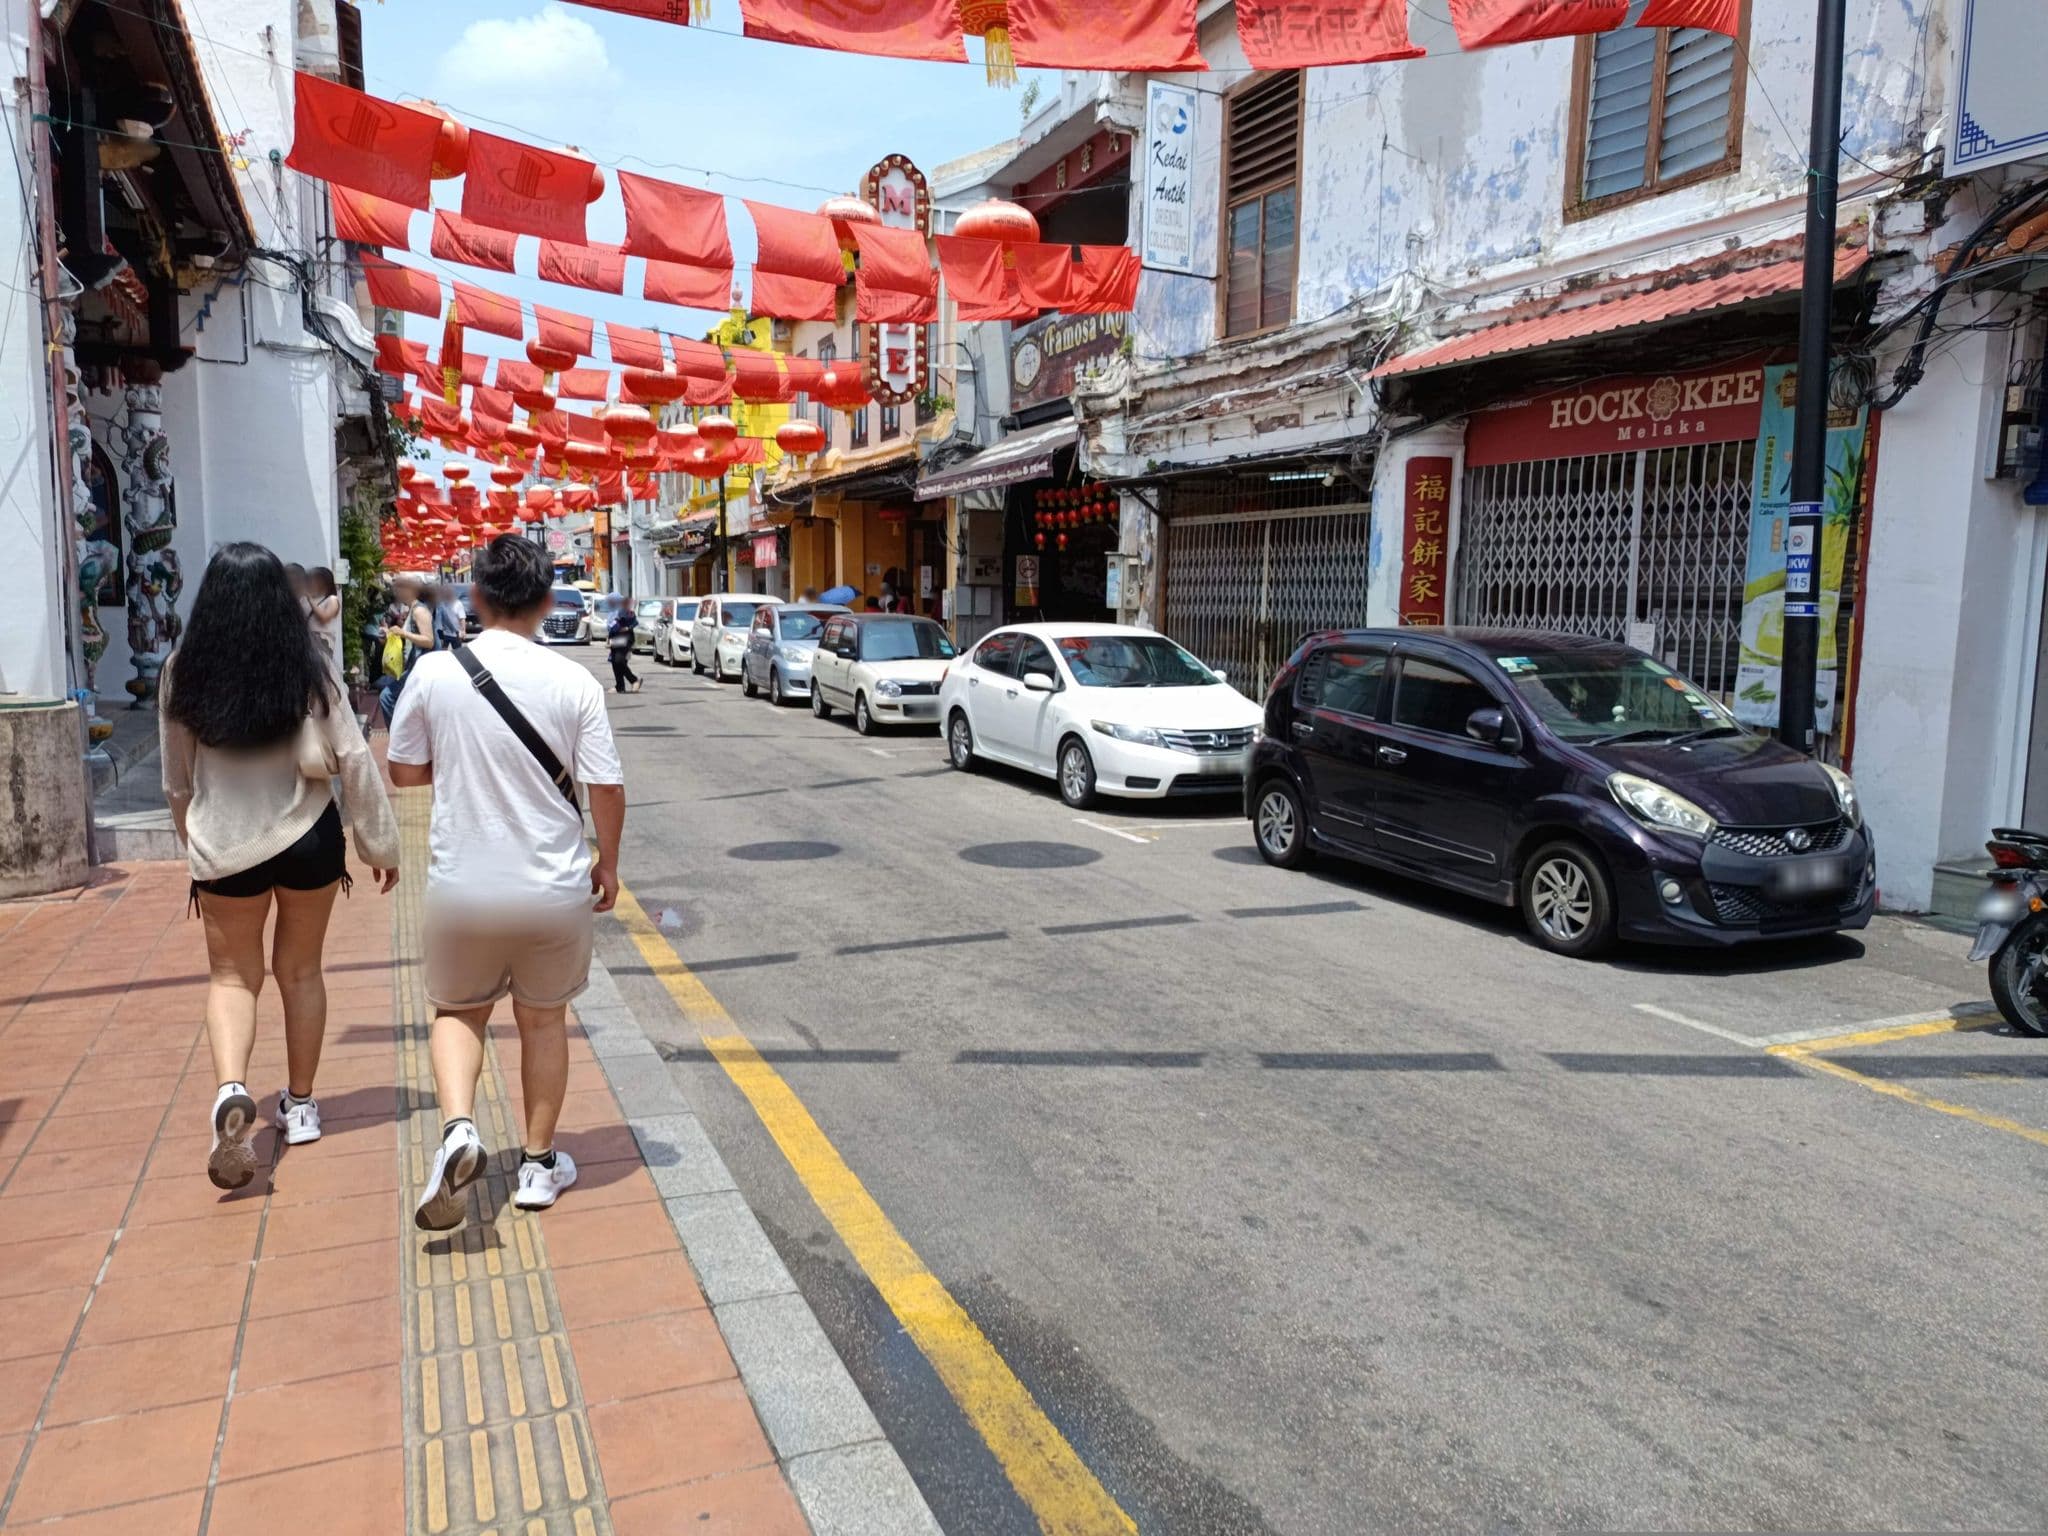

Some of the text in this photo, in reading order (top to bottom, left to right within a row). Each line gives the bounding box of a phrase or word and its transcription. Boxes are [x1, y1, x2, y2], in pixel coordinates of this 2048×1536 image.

[1153, 140, 1188, 170] Kedai
[1153, 176, 1187, 205] Antik
[1044, 316, 1097, 357] Famosa
[1549, 369, 1762, 429] HOCK KEE
[1617, 419, 1705, 441] Melaka
[1409, 474, 1446, 603] 福記餅家
